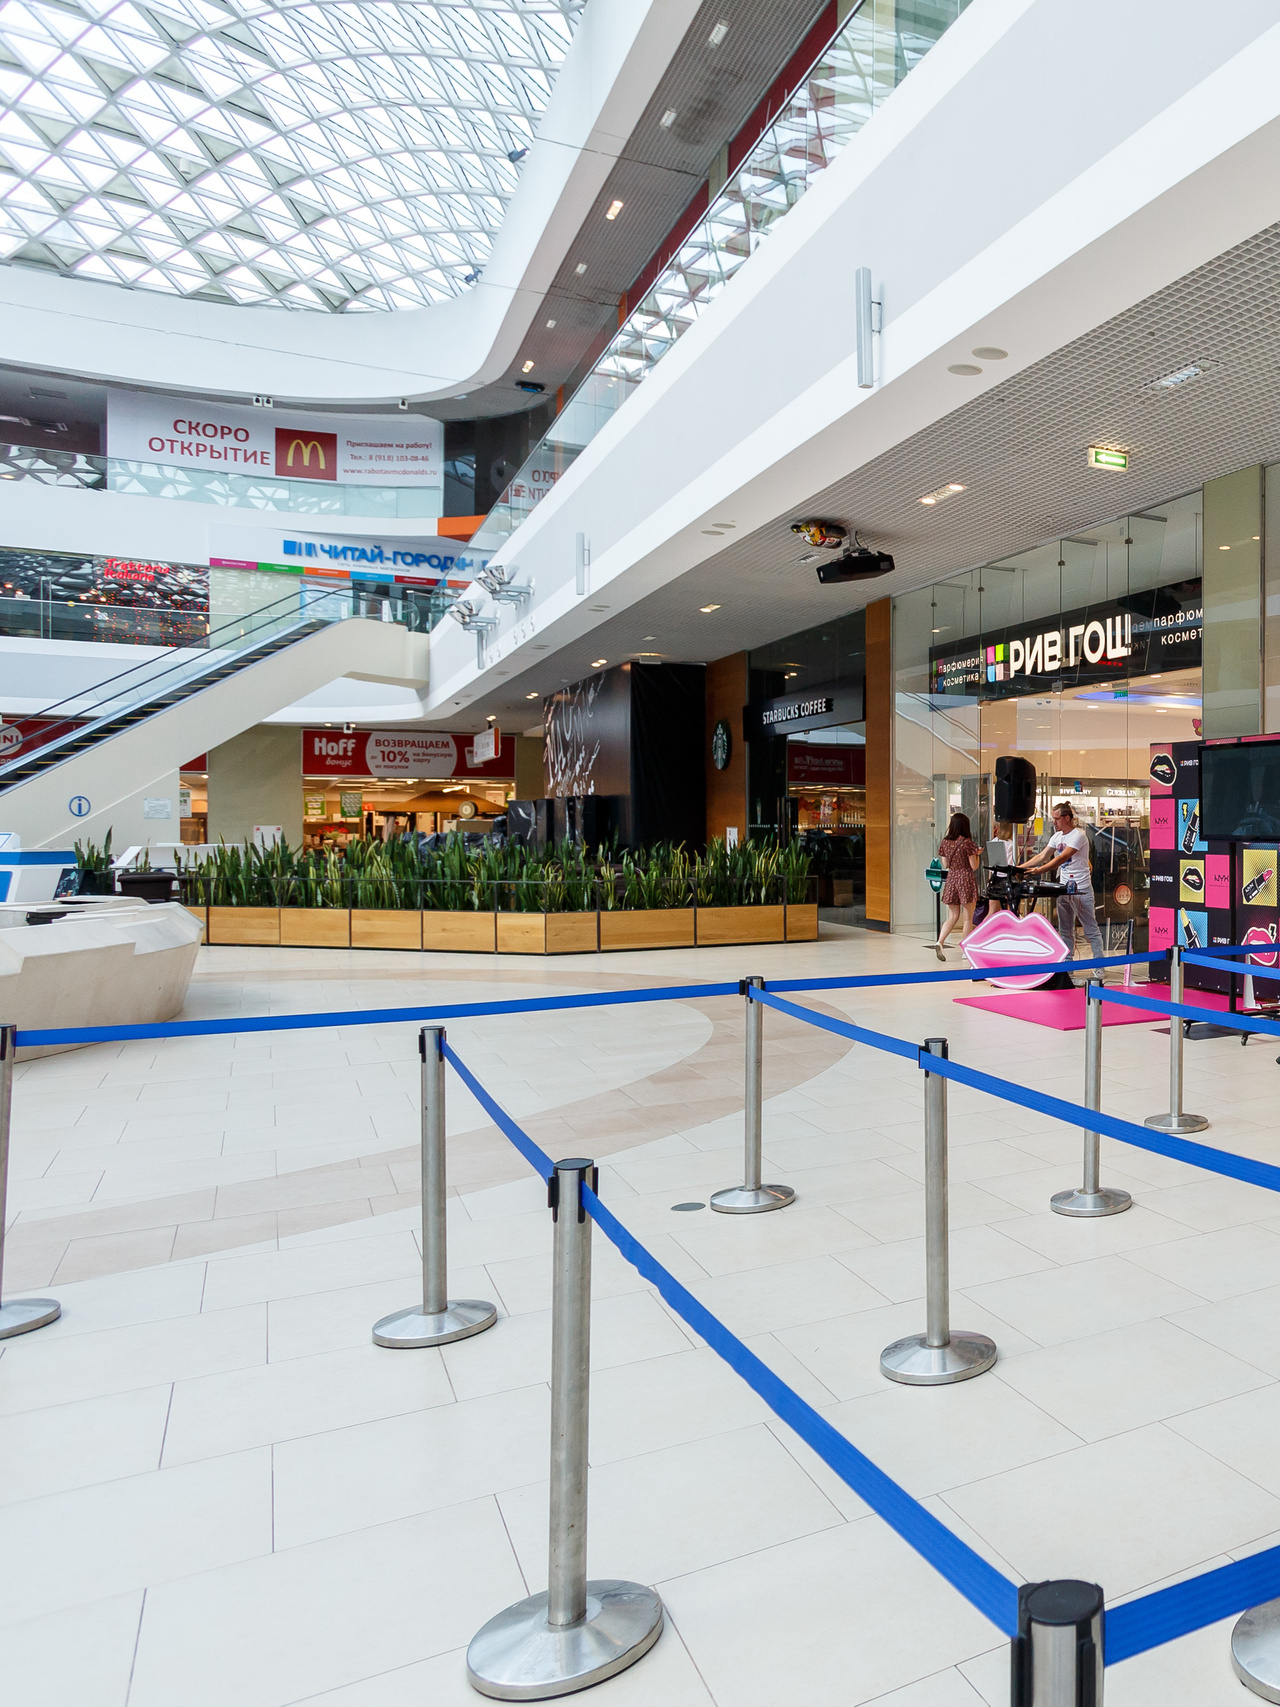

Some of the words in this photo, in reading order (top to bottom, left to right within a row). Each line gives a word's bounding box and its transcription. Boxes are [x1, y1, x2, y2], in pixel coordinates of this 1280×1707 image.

[173, 419, 250, 443] СКОРО
[148, 437, 271, 466] ОТКРЫТИЕ
[105, 558, 170, 574] Trattoria
[104, 568, 155, 582] Italiana
[1009, 631, 1061, 679] РИВ
[1069, 613, 1131, 668] ГОШ
[943, 672, 979, 688] косметика
[763, 704, 799, 725] STARBUCKS
[801, 698, 827, 717] COFFEE
[375, 739, 450, 750] ВОЗВРАЩАЕМ
[326, 757, 353, 768] бонус
[380, 750, 410, 763] 10%
[1106, 788, 1137, 797] GUERLAIN
[1155, 817, 1168, 825] NYX
[1155, 926, 1168, 934] NYX
